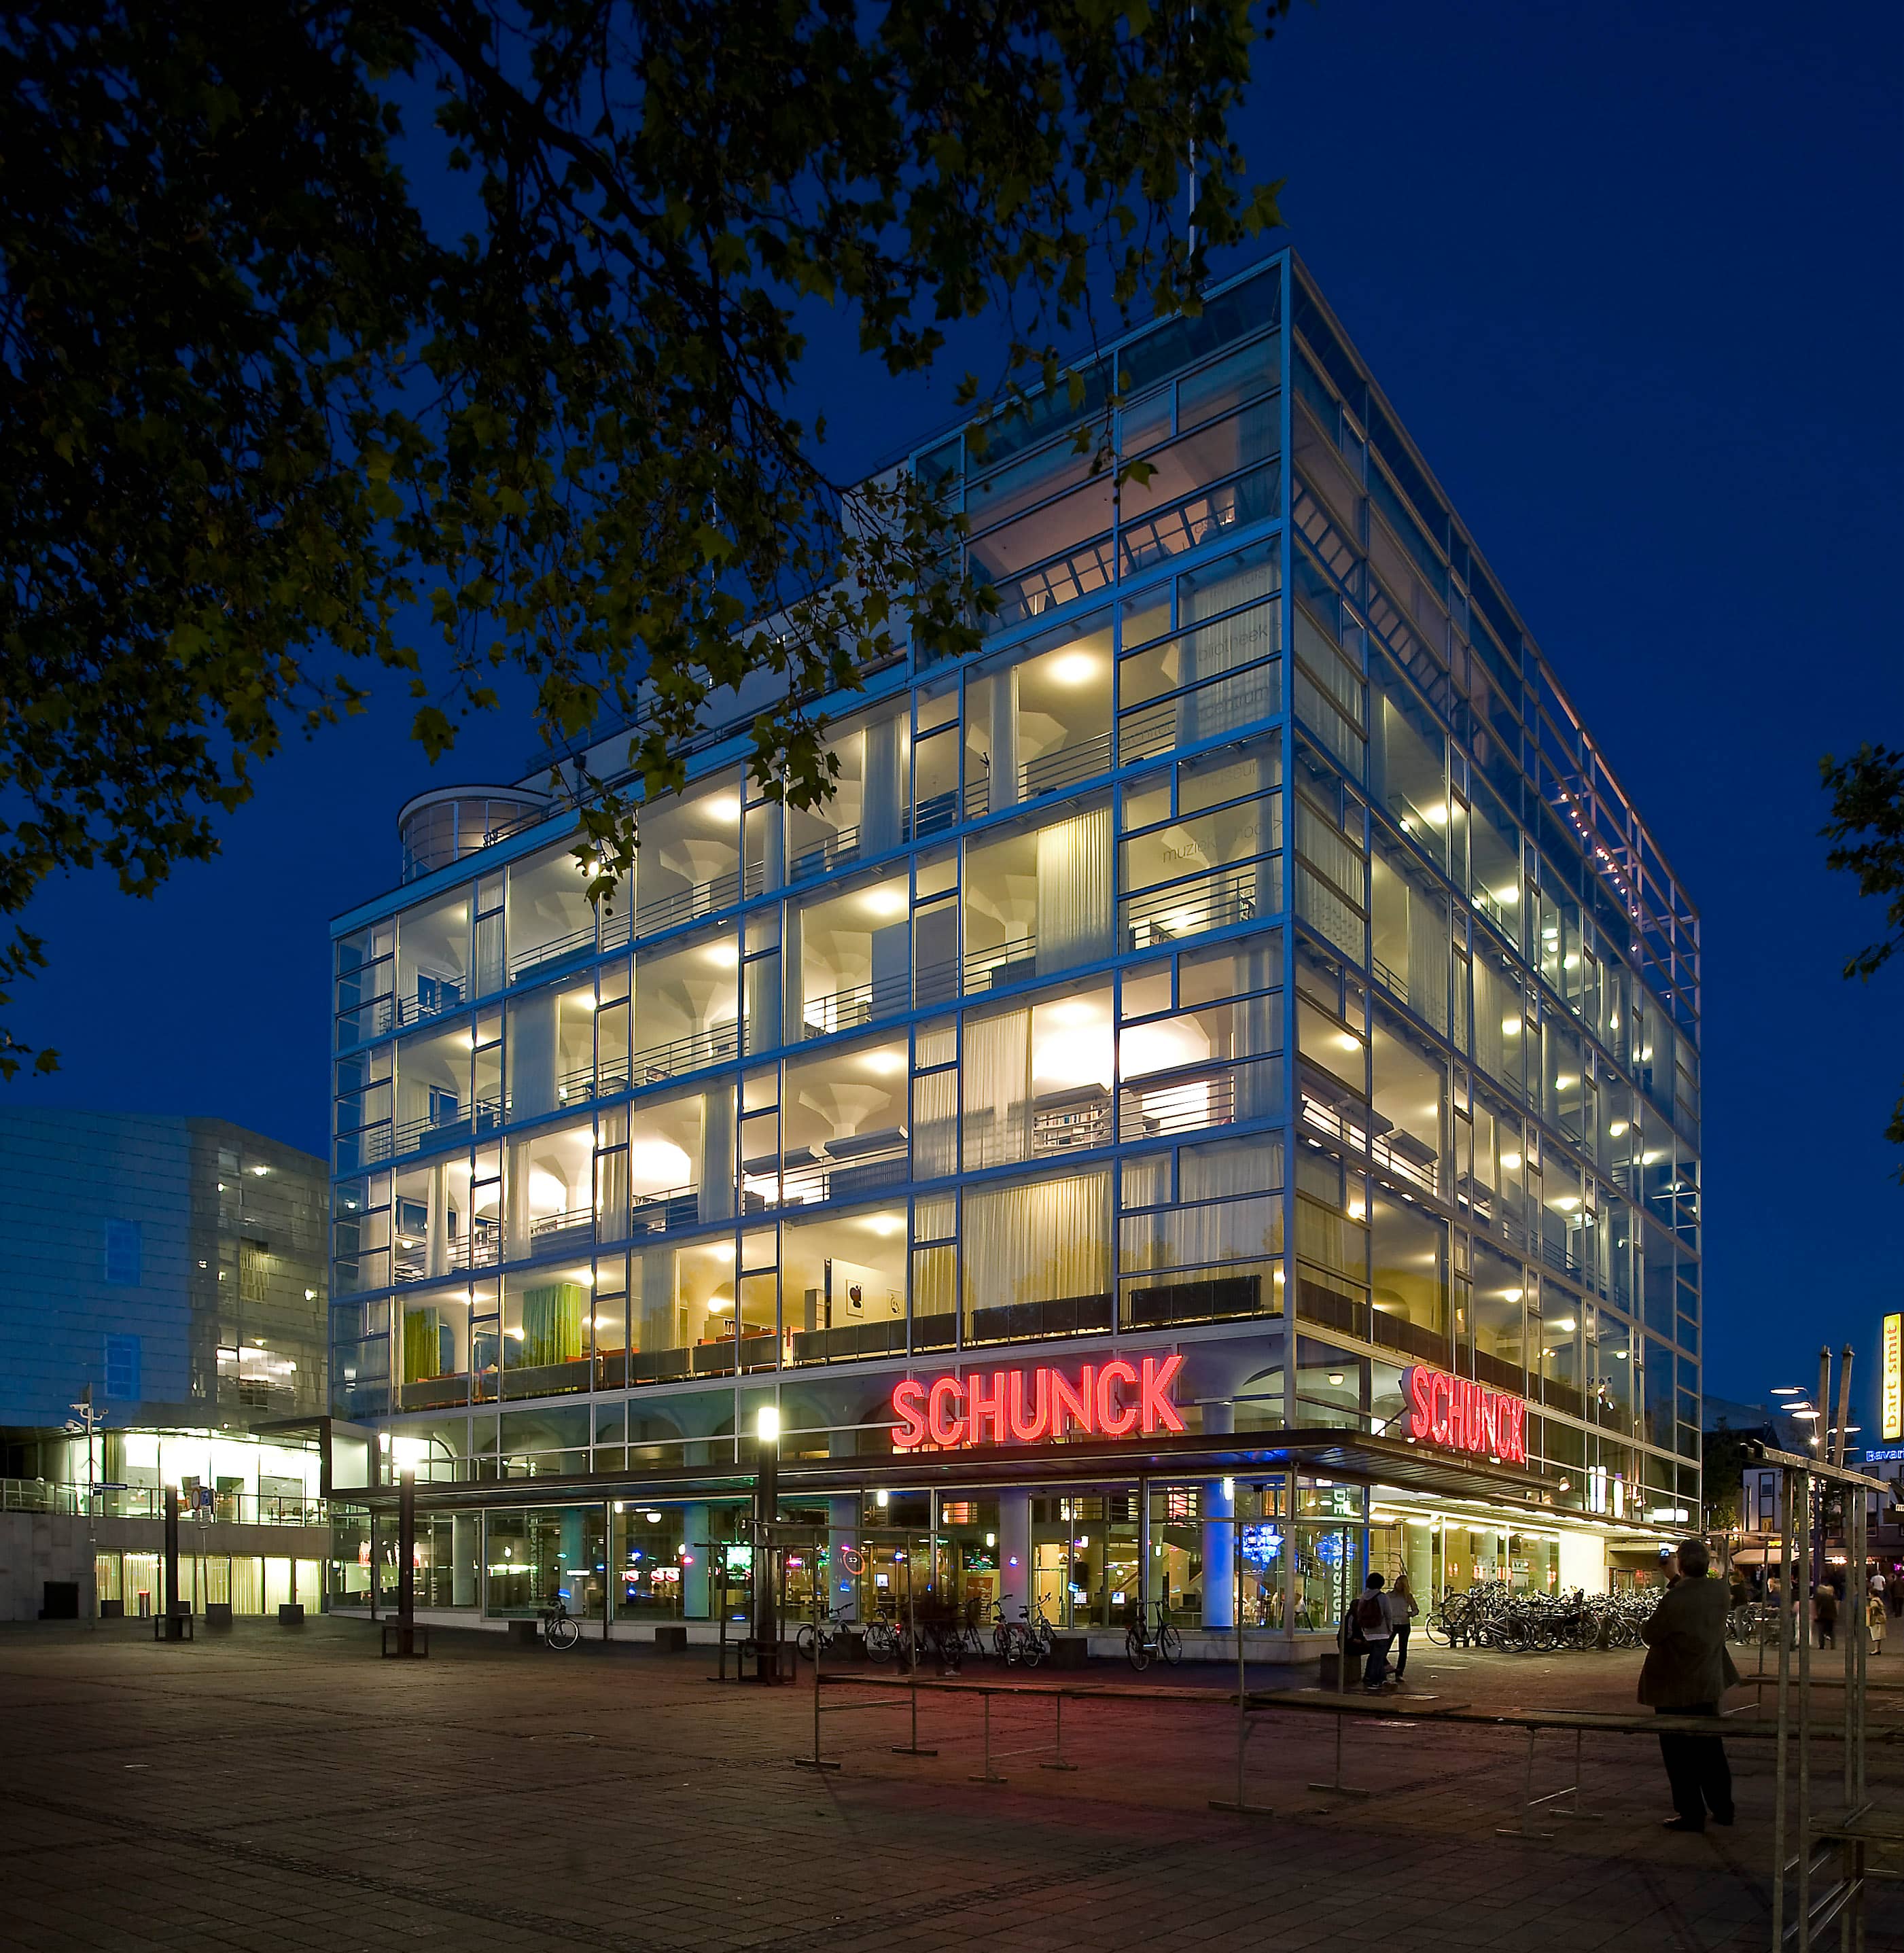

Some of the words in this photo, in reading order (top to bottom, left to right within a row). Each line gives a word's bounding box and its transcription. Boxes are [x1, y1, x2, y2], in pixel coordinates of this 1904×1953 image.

[1886, 1324, 1897, 1373] smit
[892, 1354, 1186, 1447] SCHUNCK
[1405, 1365, 1526, 1463] SCHUNCK
[1886, 1380, 1897, 1428] bart
[1334, 1489, 1346, 1515] DE
[1333, 1532, 1344, 1622] PASSAGE
